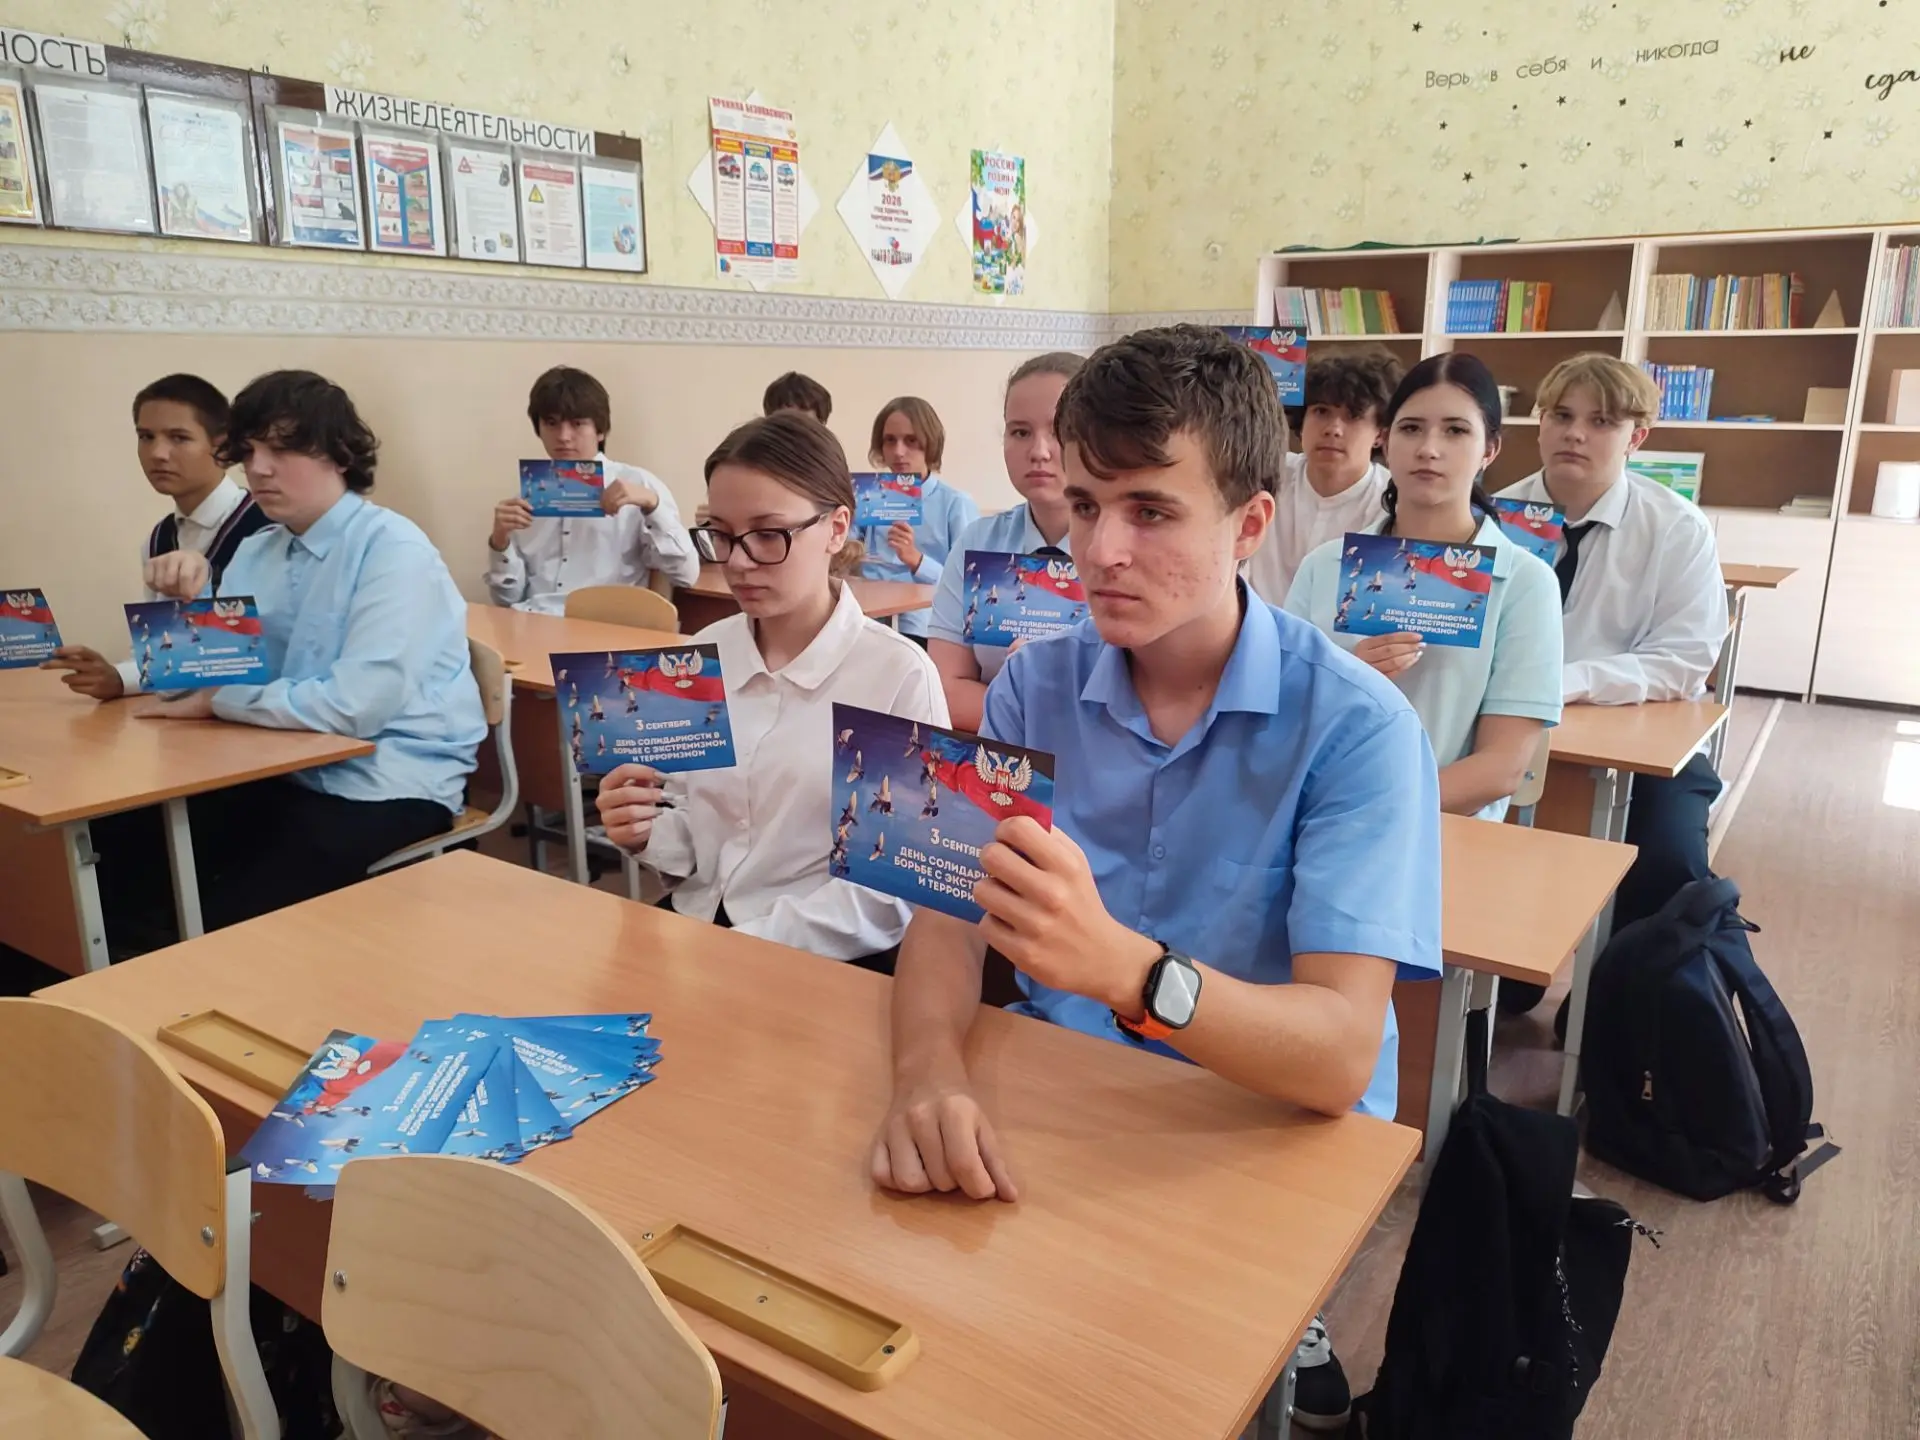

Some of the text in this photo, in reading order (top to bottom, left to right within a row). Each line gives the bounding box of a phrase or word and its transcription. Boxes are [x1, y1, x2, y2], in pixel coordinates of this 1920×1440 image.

[1425, 39, 1816, 89] Верь в себя и никогда не
[333, 88, 592, 154] ЖИЗНЕДЕЯТЕЛЬНОСТИ
[1409, 595, 1456, 609] 3 СЕНТЯБРЯ
[1020, 606, 1027, 616] 3
[1385, 608, 1405, 617] ДЕНЬ
[1406, 610, 1468, 623] СОЛИДАРНОСТИ
[1404, 624, 1458, 635] ТЕРРОРИЗМОМ
[635, 719, 692, 731] 3 СЕНТЯБРЯ
[612, 739, 727, 755] БОРЬБЕ С ЭКСТРЕМИЗМОМ
[615, 739, 637, 747] ДЕНЬ
[637, 732, 712, 746] СОЛИДАРНОСТИ
[632, 749, 706, 763] И ТЕРРОРИЗМОМ
[930, 827, 940, 845] 3
[900, 846, 927, 862] ДЕНЬ
[894, 855, 976, 890] БОРЬБЕ С ЭКСТ
[918, 875, 926, 887] И
